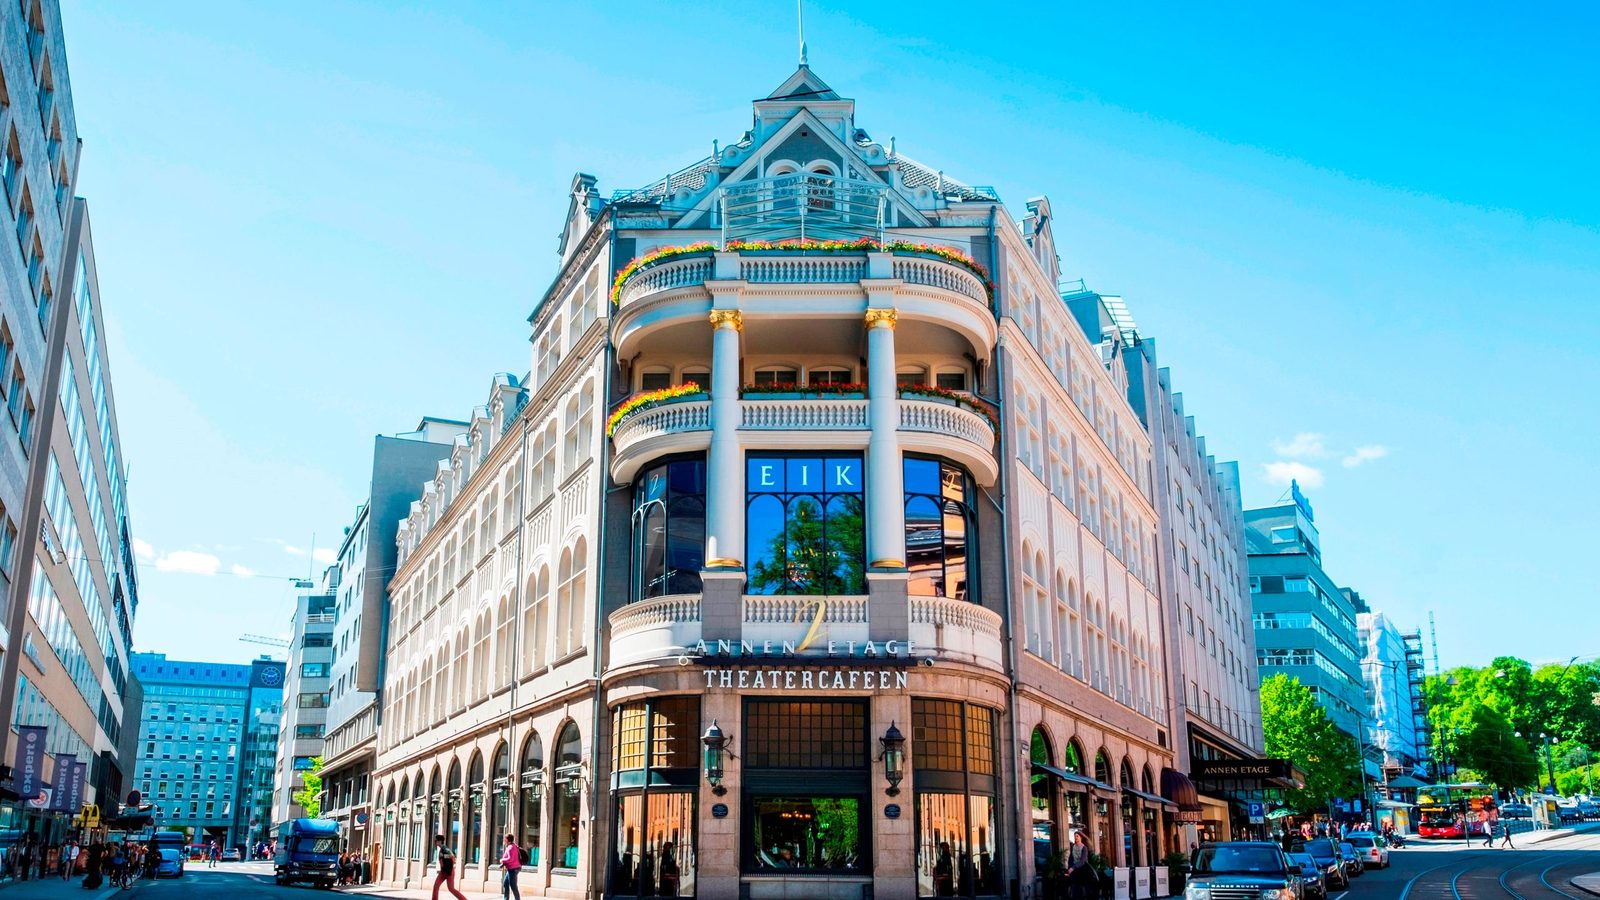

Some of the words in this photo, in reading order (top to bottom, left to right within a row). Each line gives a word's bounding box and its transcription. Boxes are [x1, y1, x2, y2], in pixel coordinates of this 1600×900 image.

[761, 466, 854, 486] EIK
[695, 639, 796, 654] ANNEN
[827, 640, 917, 655] ETAGE
[703, 669, 908, 689] THEATERCAFEEN
[23, 743, 36, 794] expert
[1204, 766, 1237, 775] ANNEN
[1241, 766, 1270, 774] ETAGE
[55, 767, 67, 807] expert
[69, 774, 80, 810] expert
[1252, 805, 1260, 815] P
